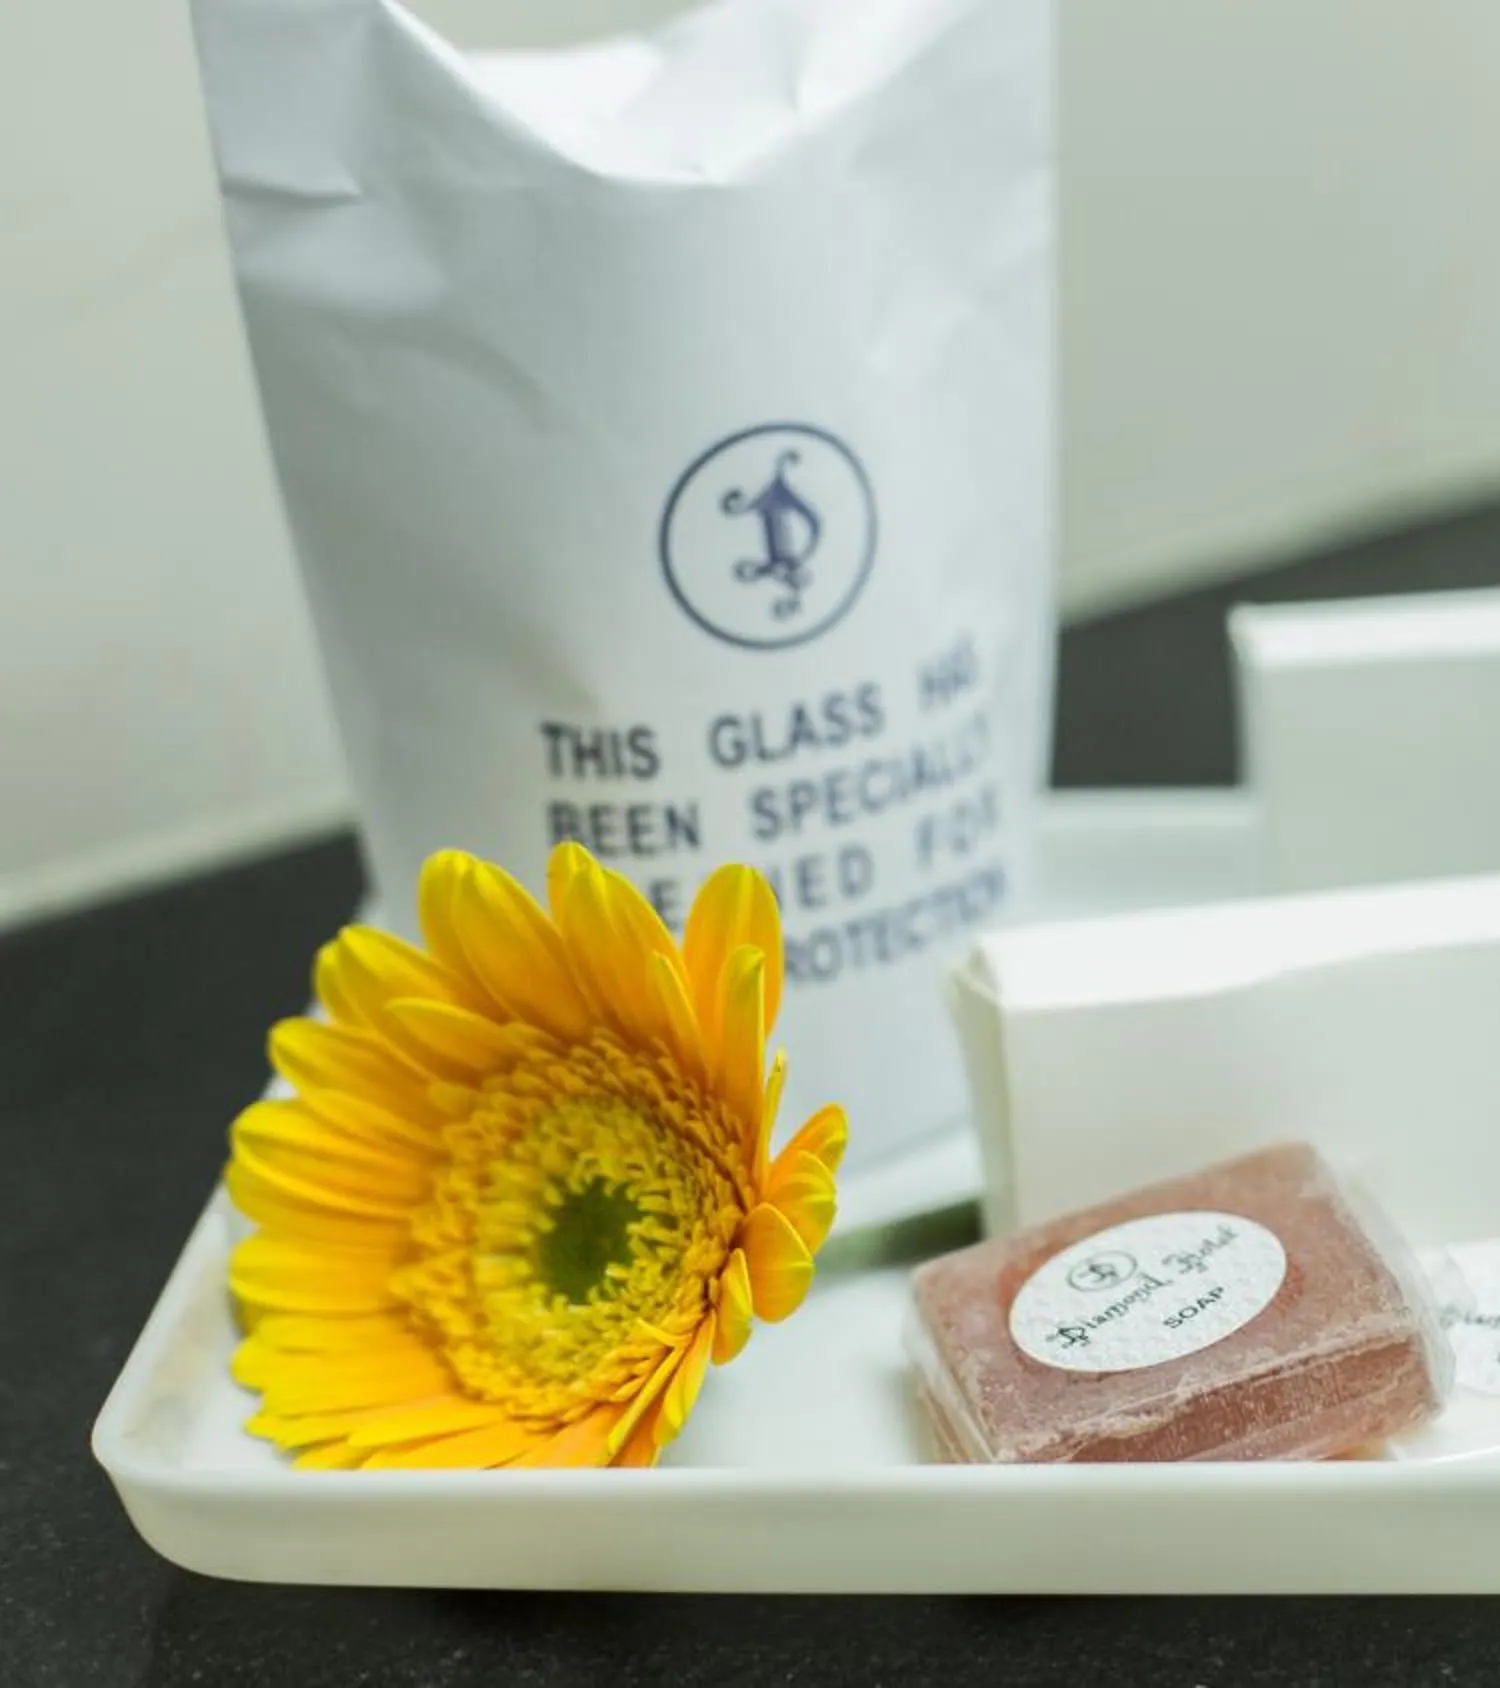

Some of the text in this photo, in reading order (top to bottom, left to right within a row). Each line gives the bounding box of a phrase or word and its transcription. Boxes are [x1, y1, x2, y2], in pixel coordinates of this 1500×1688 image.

[541, 720, 660, 780] THIS
[707, 682, 884, 770] GLASS
[549, 801, 700, 858] BEEN
[784, 862, 1007, 982] ROTECTION
[1045, 1270, 1174, 1350] Diamond
[1162, 1286, 1225, 1329] SOAP
